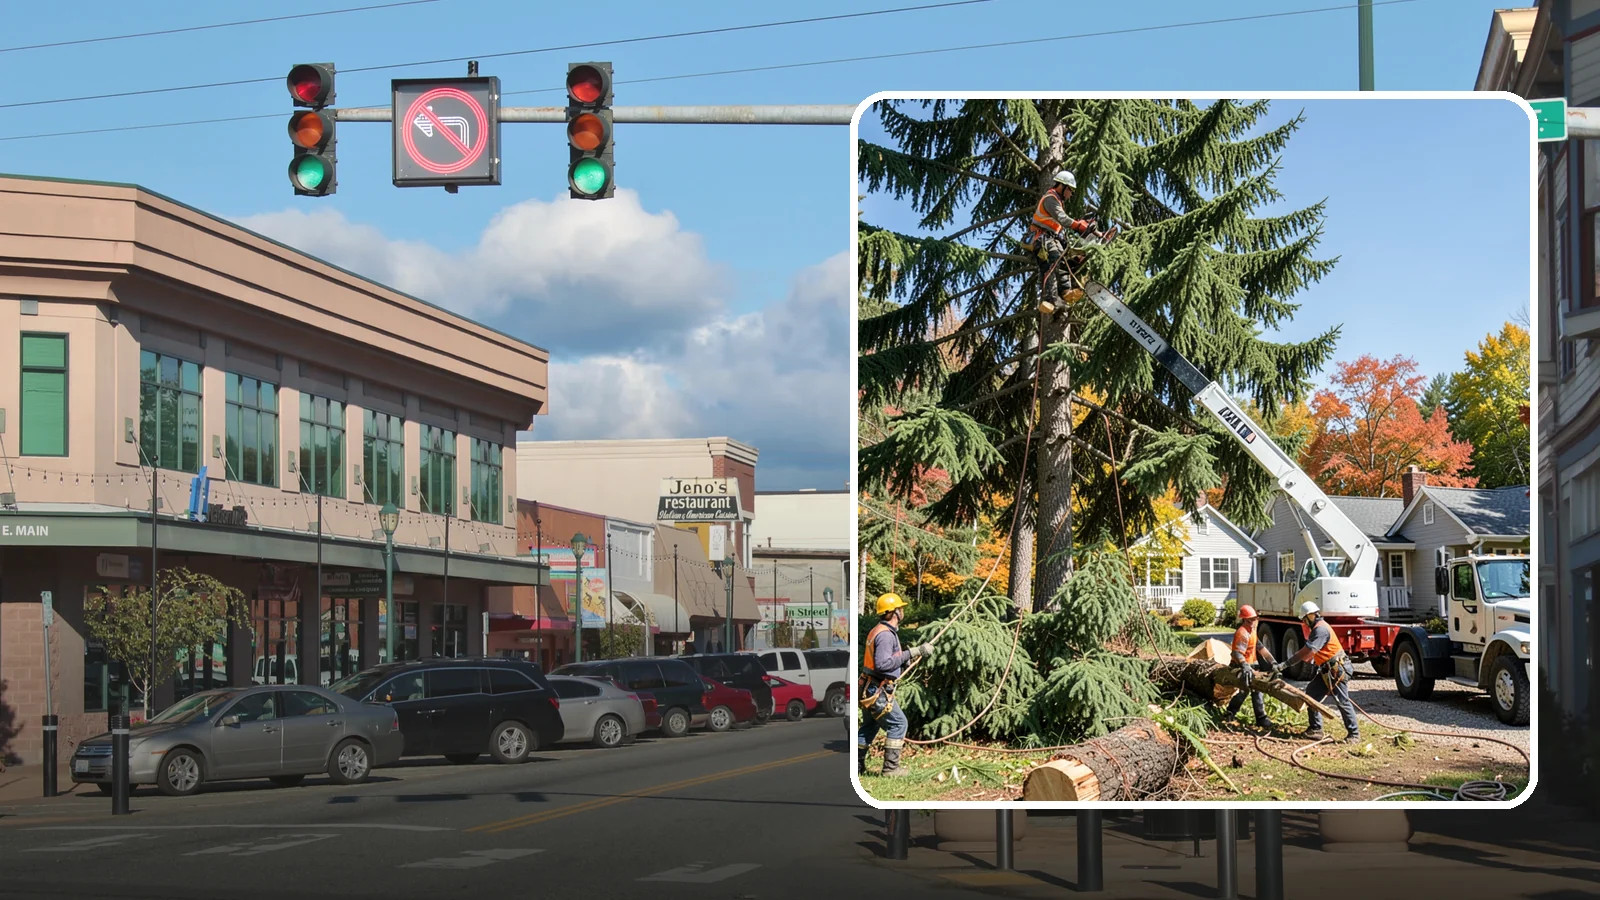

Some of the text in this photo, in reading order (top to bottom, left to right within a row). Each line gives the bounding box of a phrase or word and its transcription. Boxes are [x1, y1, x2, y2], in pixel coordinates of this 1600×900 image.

[669, 480, 728, 495] Jeno's
[665, 496, 731, 509] restaurant
[686, 509, 714, 520] American
[715, 509, 738, 519] Cuisine
[2, 525, 49, 536] E. MAIN
[785, 608, 795, 617] in
[797, 608, 828, 617] Street
[790, 619, 824, 627] lass
